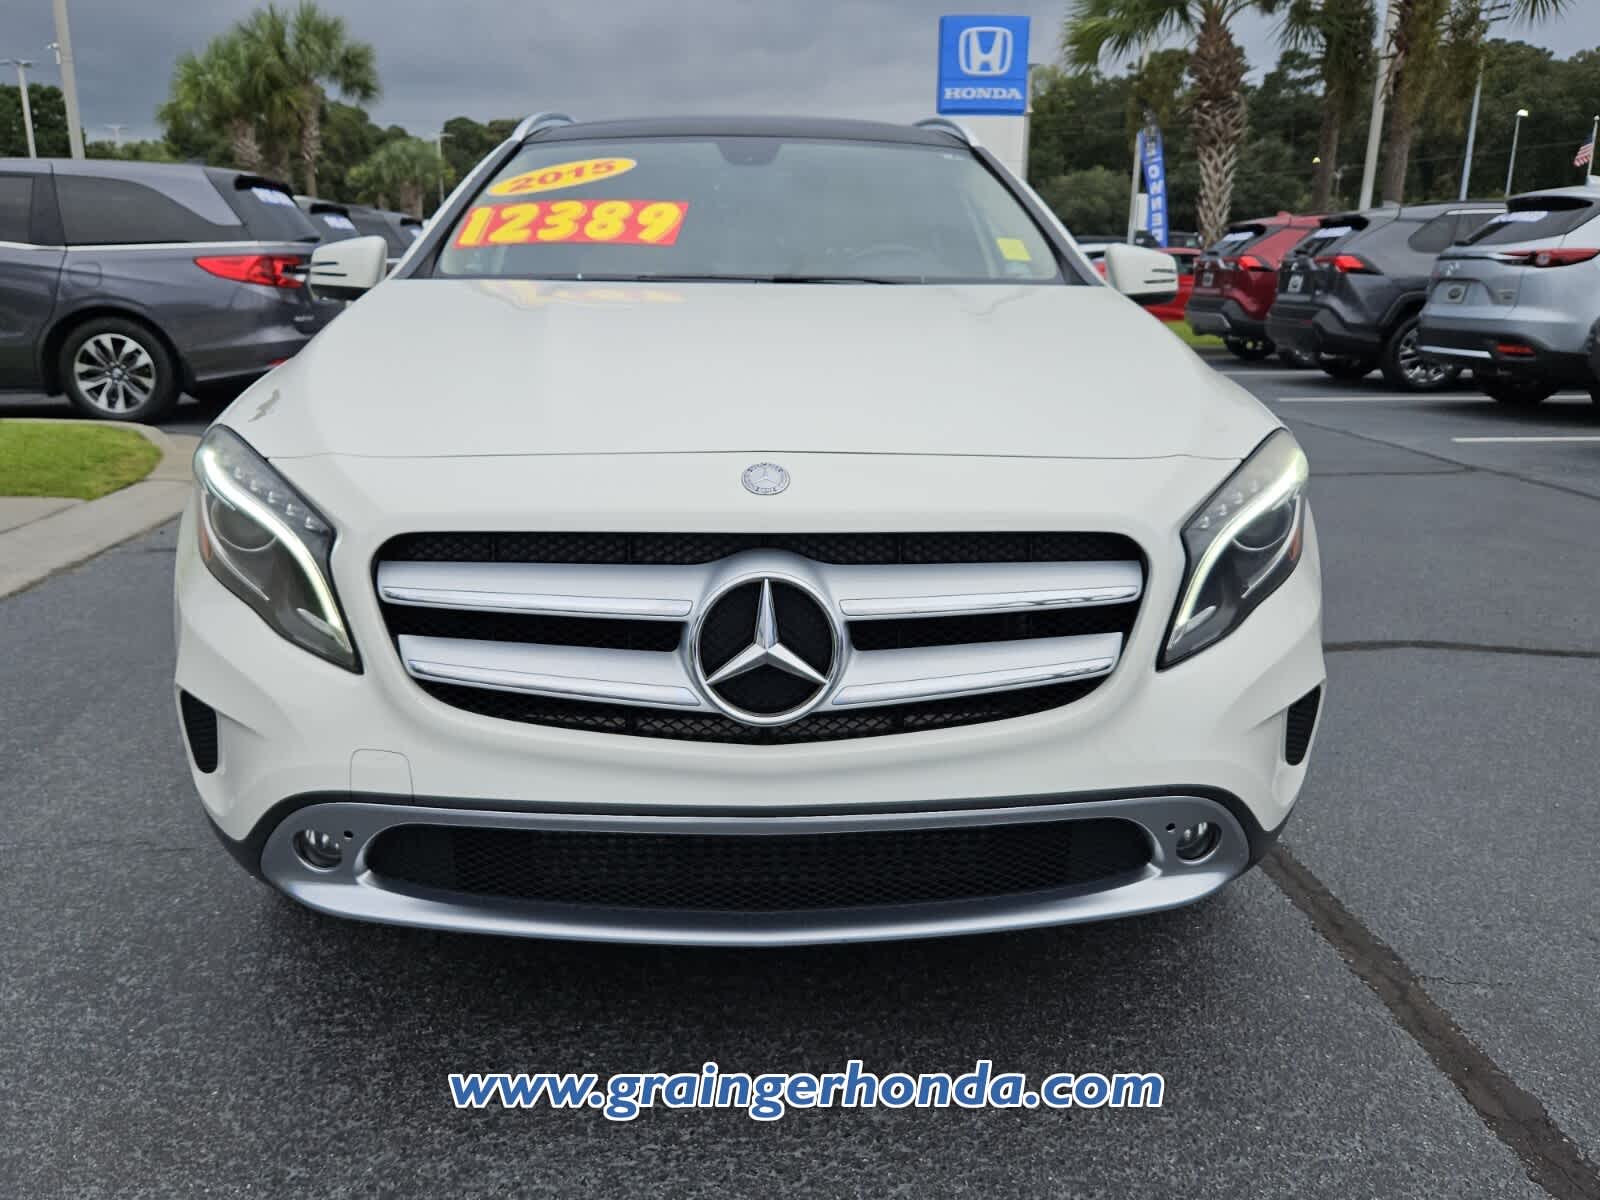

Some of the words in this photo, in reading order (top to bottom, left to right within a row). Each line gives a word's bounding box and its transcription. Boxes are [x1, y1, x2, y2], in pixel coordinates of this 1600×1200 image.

[943, 87, 1023, 100] HONDA
[508, 160, 617, 192] 2015
[457, 200, 682, 246] 12389
